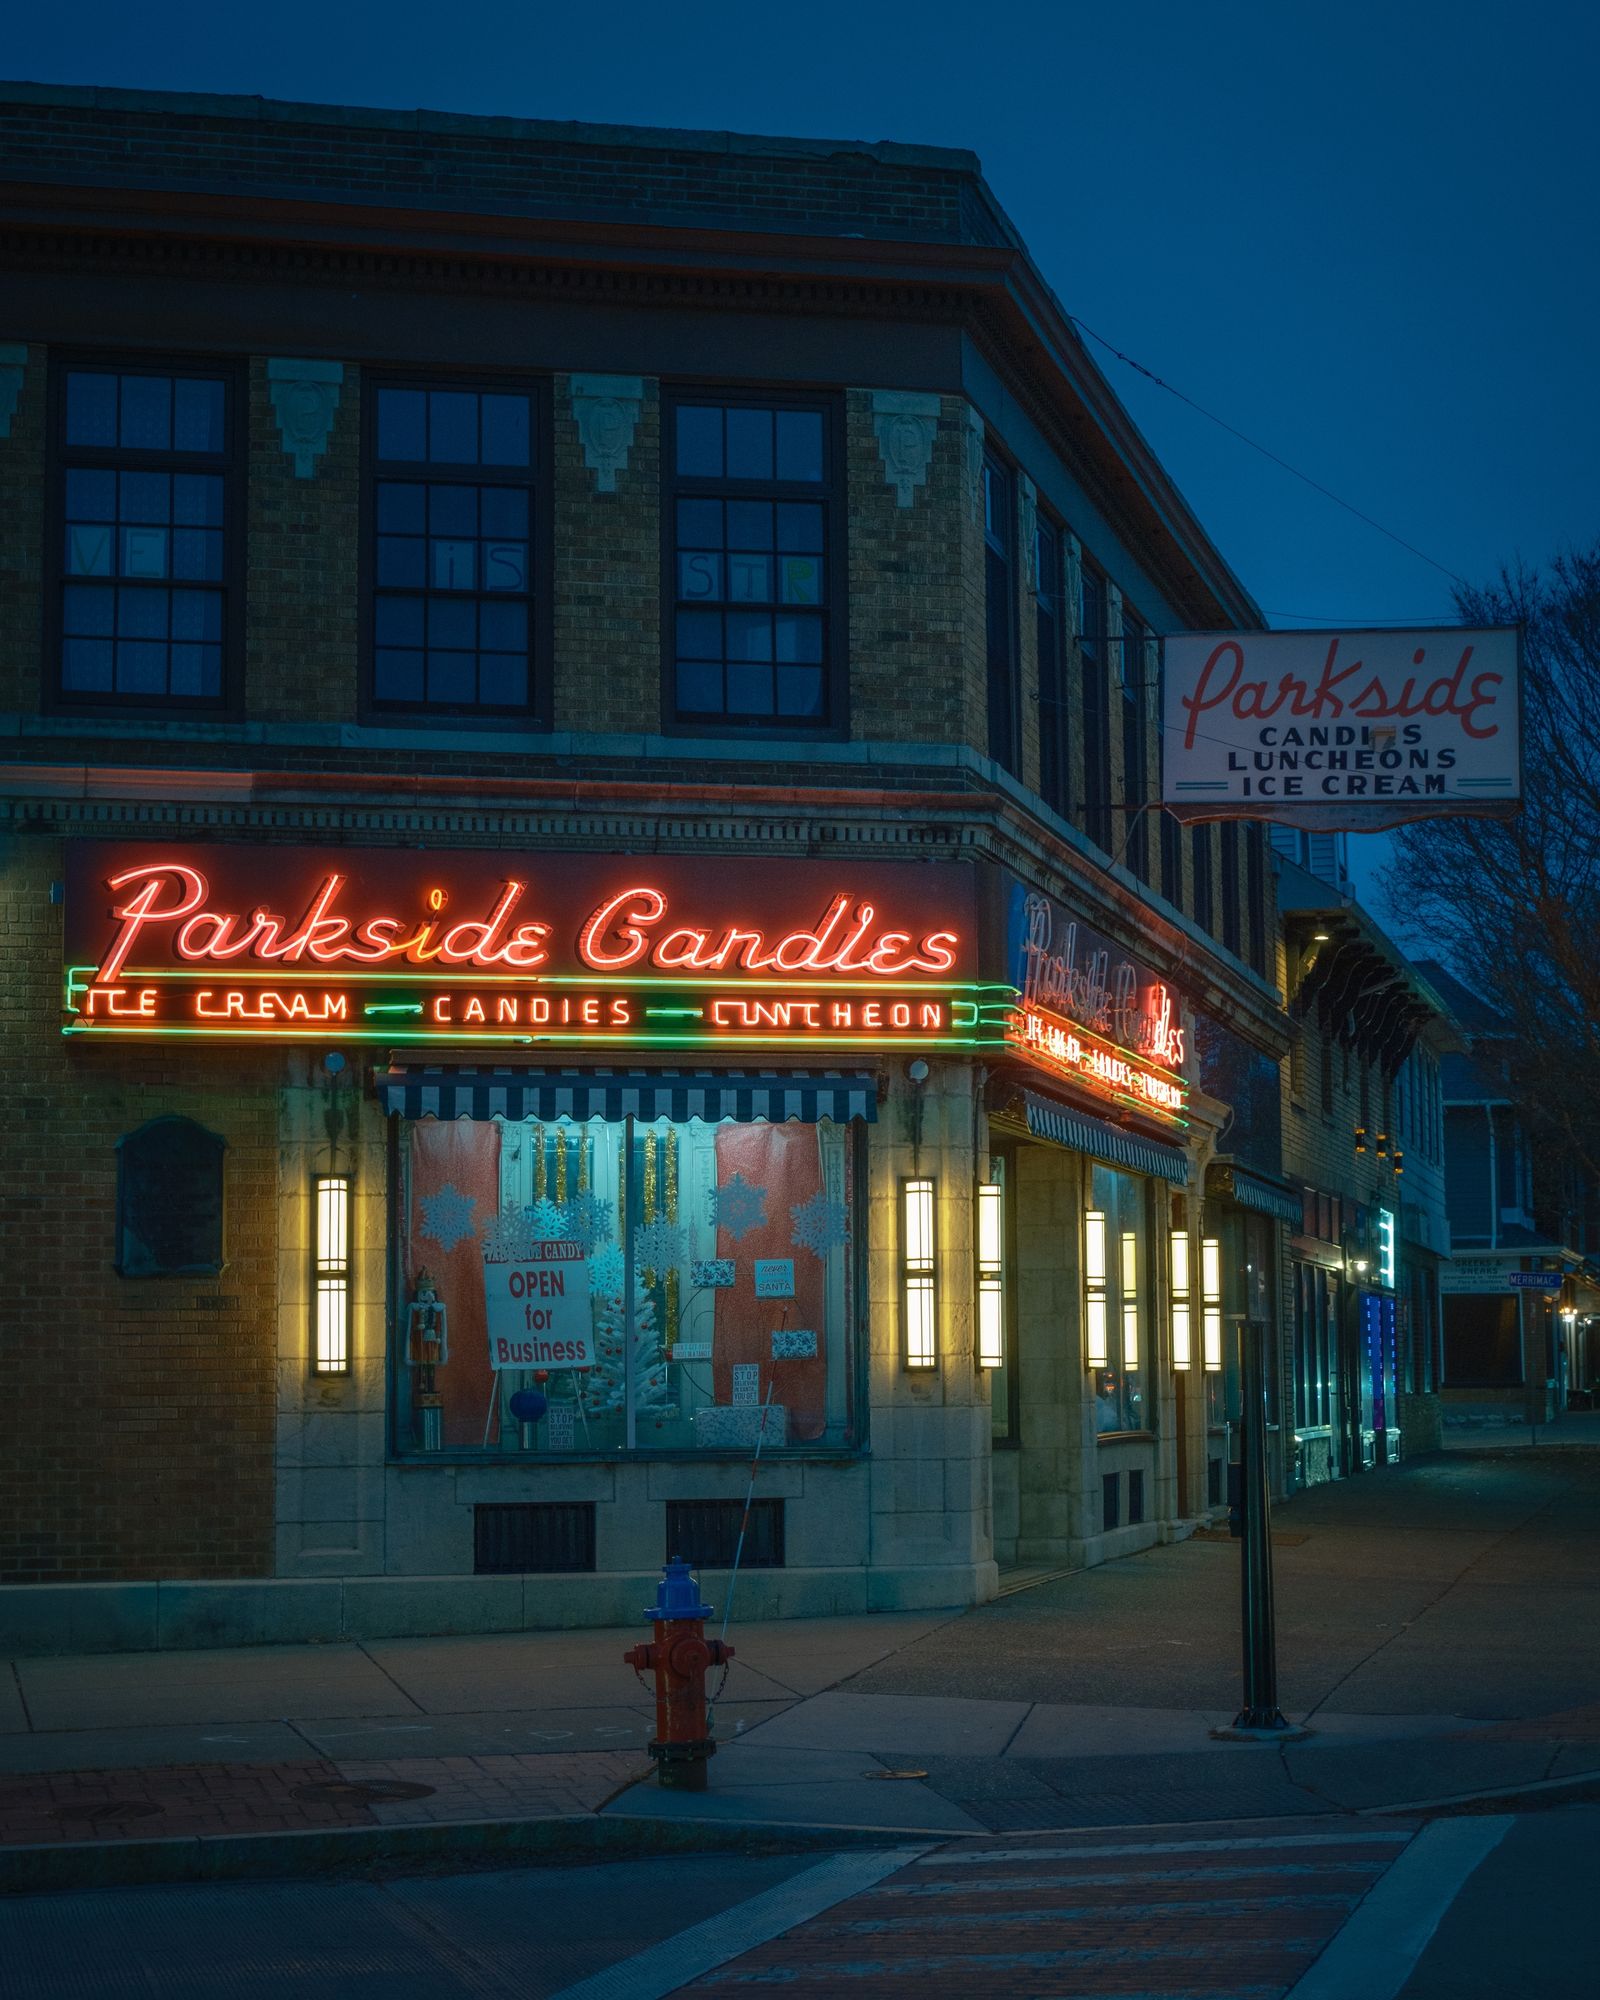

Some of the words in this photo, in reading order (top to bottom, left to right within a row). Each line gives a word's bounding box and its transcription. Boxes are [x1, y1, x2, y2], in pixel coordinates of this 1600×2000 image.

[685, 555, 814, 602] STR
[1182, 638, 1504, 750] Parkside
[1259, 724, 1422, 747] CANDIS
[1228, 748, 1457, 772] LUNCHEONS
[1243, 776, 1304, 797] ICE
[1321, 774, 1445, 796] CREAM
[107, 862, 552, 983] Parkside
[577, 886, 961, 973] Candies
[197, 990, 348, 1020] CREAM
[434, 995, 631, 1025] CANDIES
[544, 1243, 582, 1262] CANDY
[508, 1270, 565, 1299] OPEN
[758, 1282, 792, 1292] SANTA
[1510, 1274, 1554, 1286] MERRIMAC
[525, 1303, 553, 1331] for
[497, 1336, 586, 1364] Business
[734, 1371, 758, 1381] STOP
[550, 1414, 574, 1424] STOP
